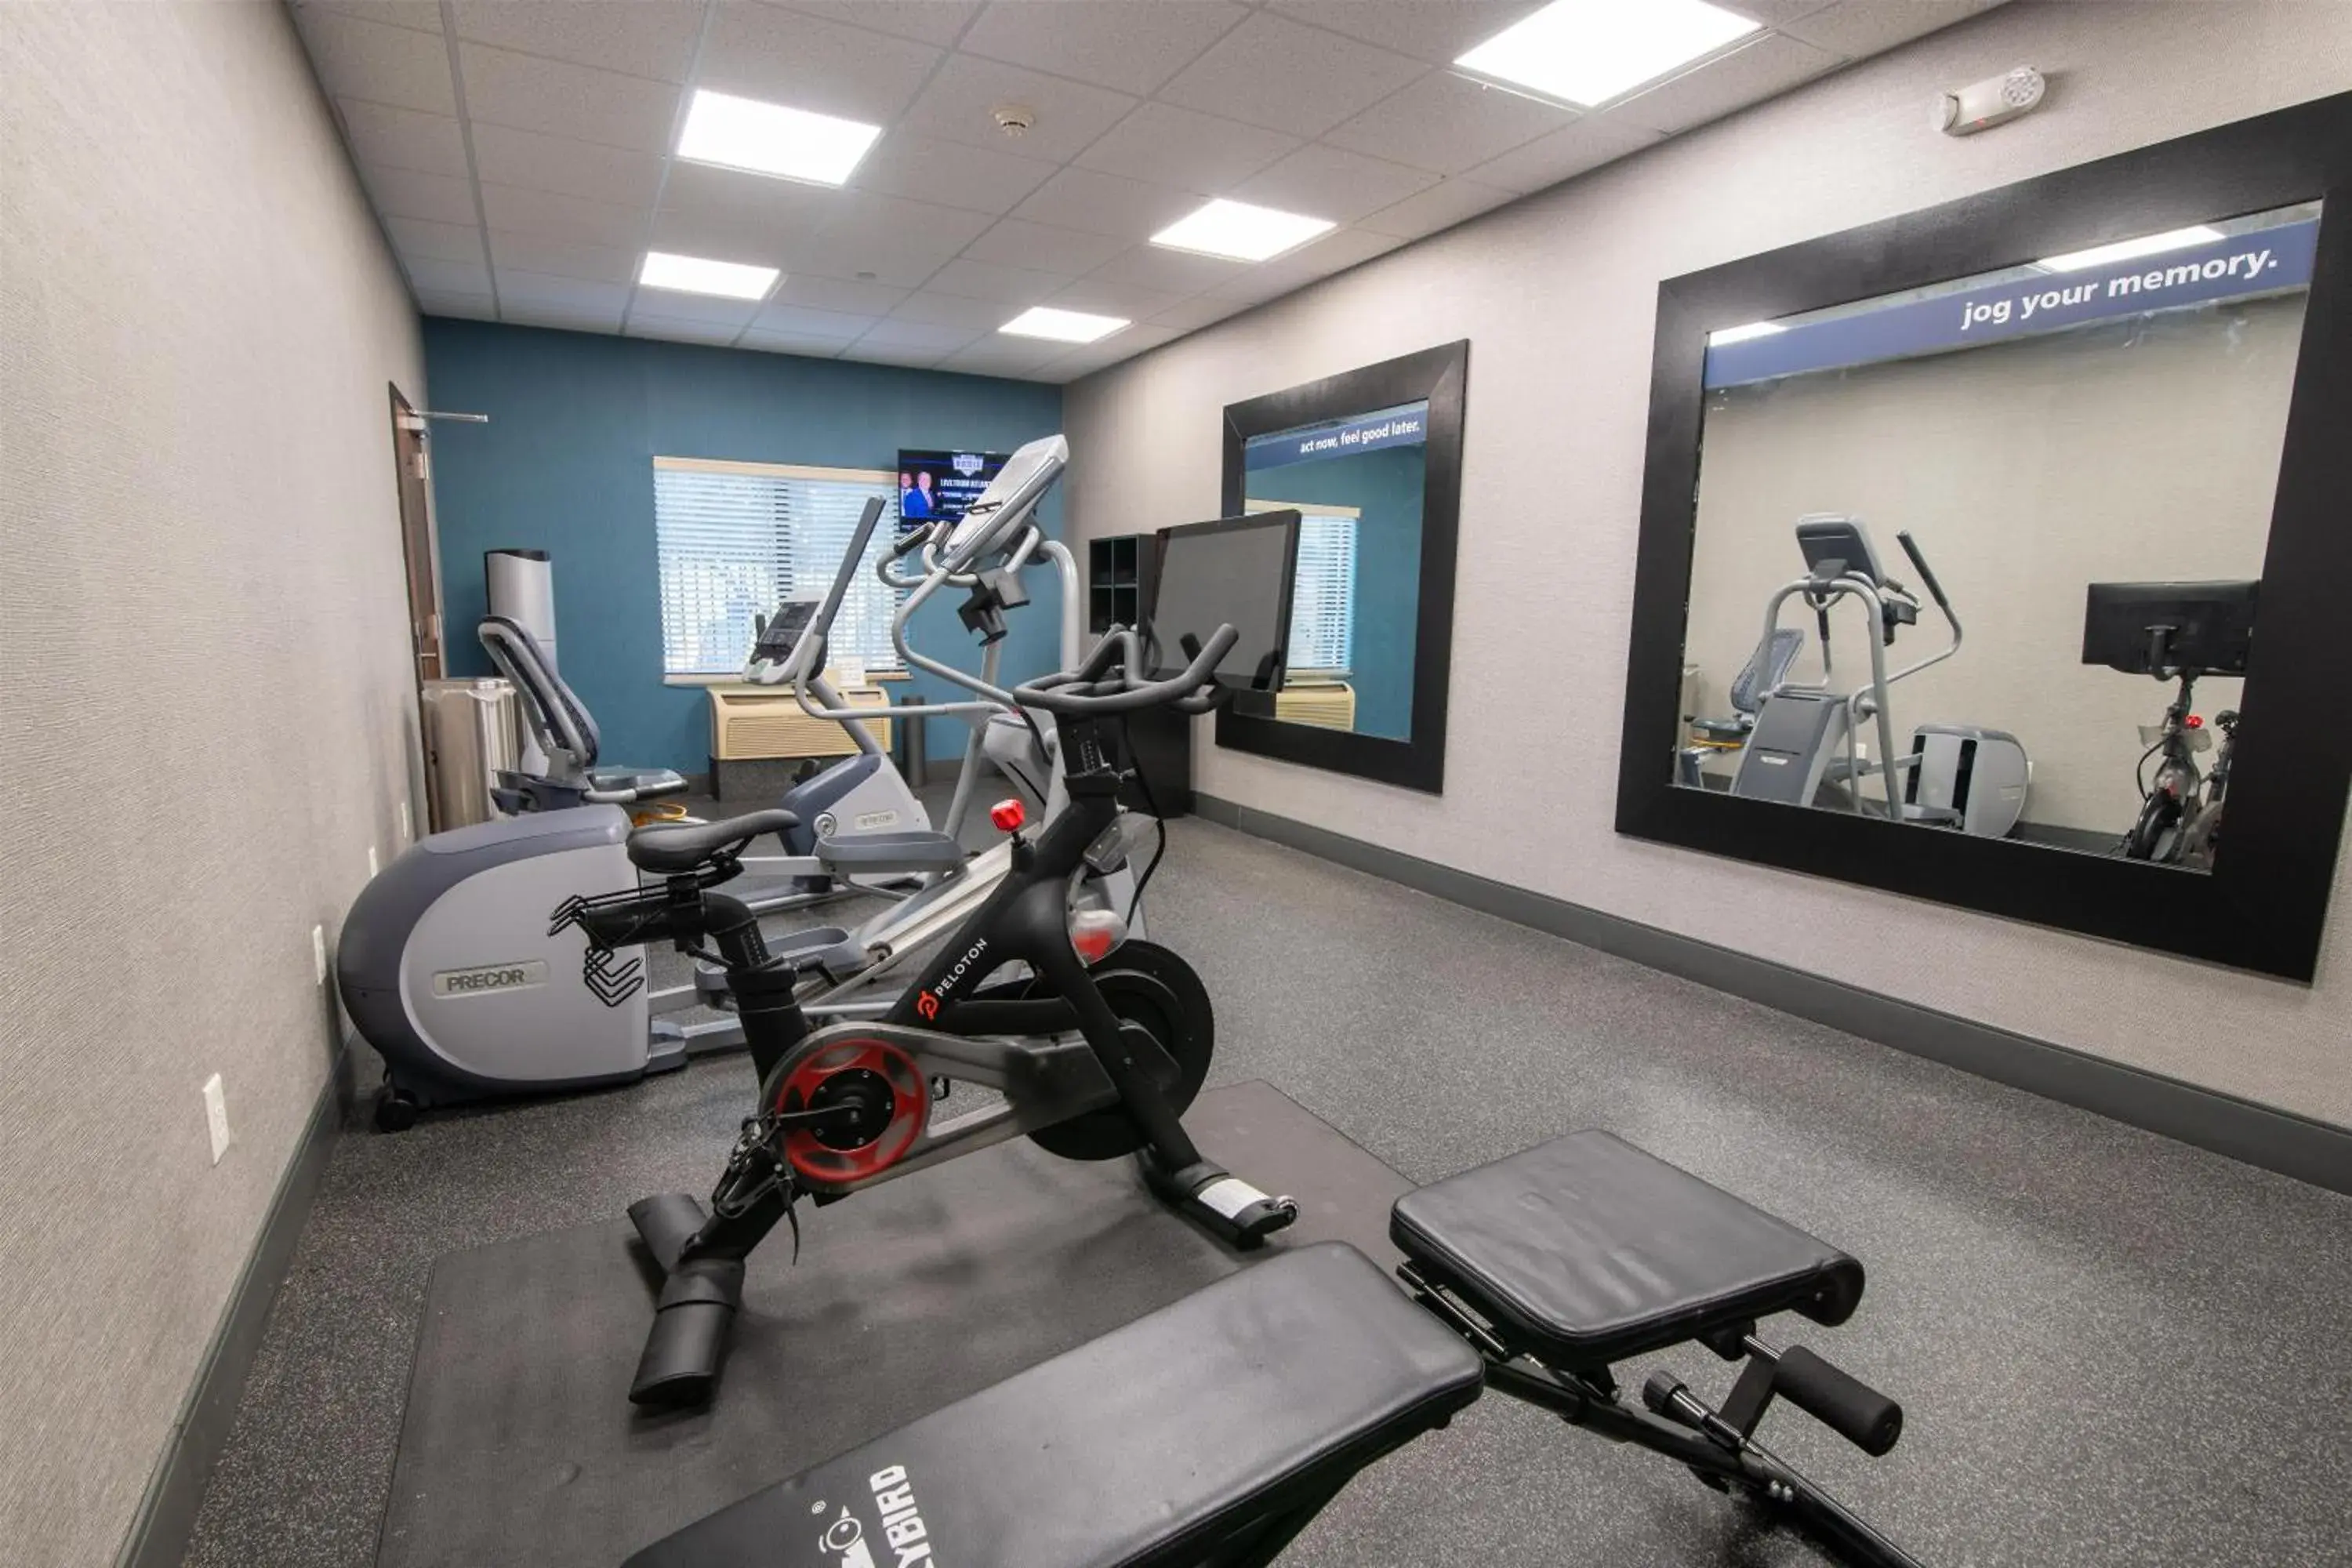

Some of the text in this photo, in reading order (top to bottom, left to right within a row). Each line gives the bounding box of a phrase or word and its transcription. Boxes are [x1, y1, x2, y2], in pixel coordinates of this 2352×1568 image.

[1961, 249, 2278, 329] jog your memory.
[1300, 420, 1420, 453] act now, feel good later.
[447, 969, 524, 991] PRECOR
[935, 938, 988, 996] PELOTON
[869, 1465, 935, 1568] YBIRD
